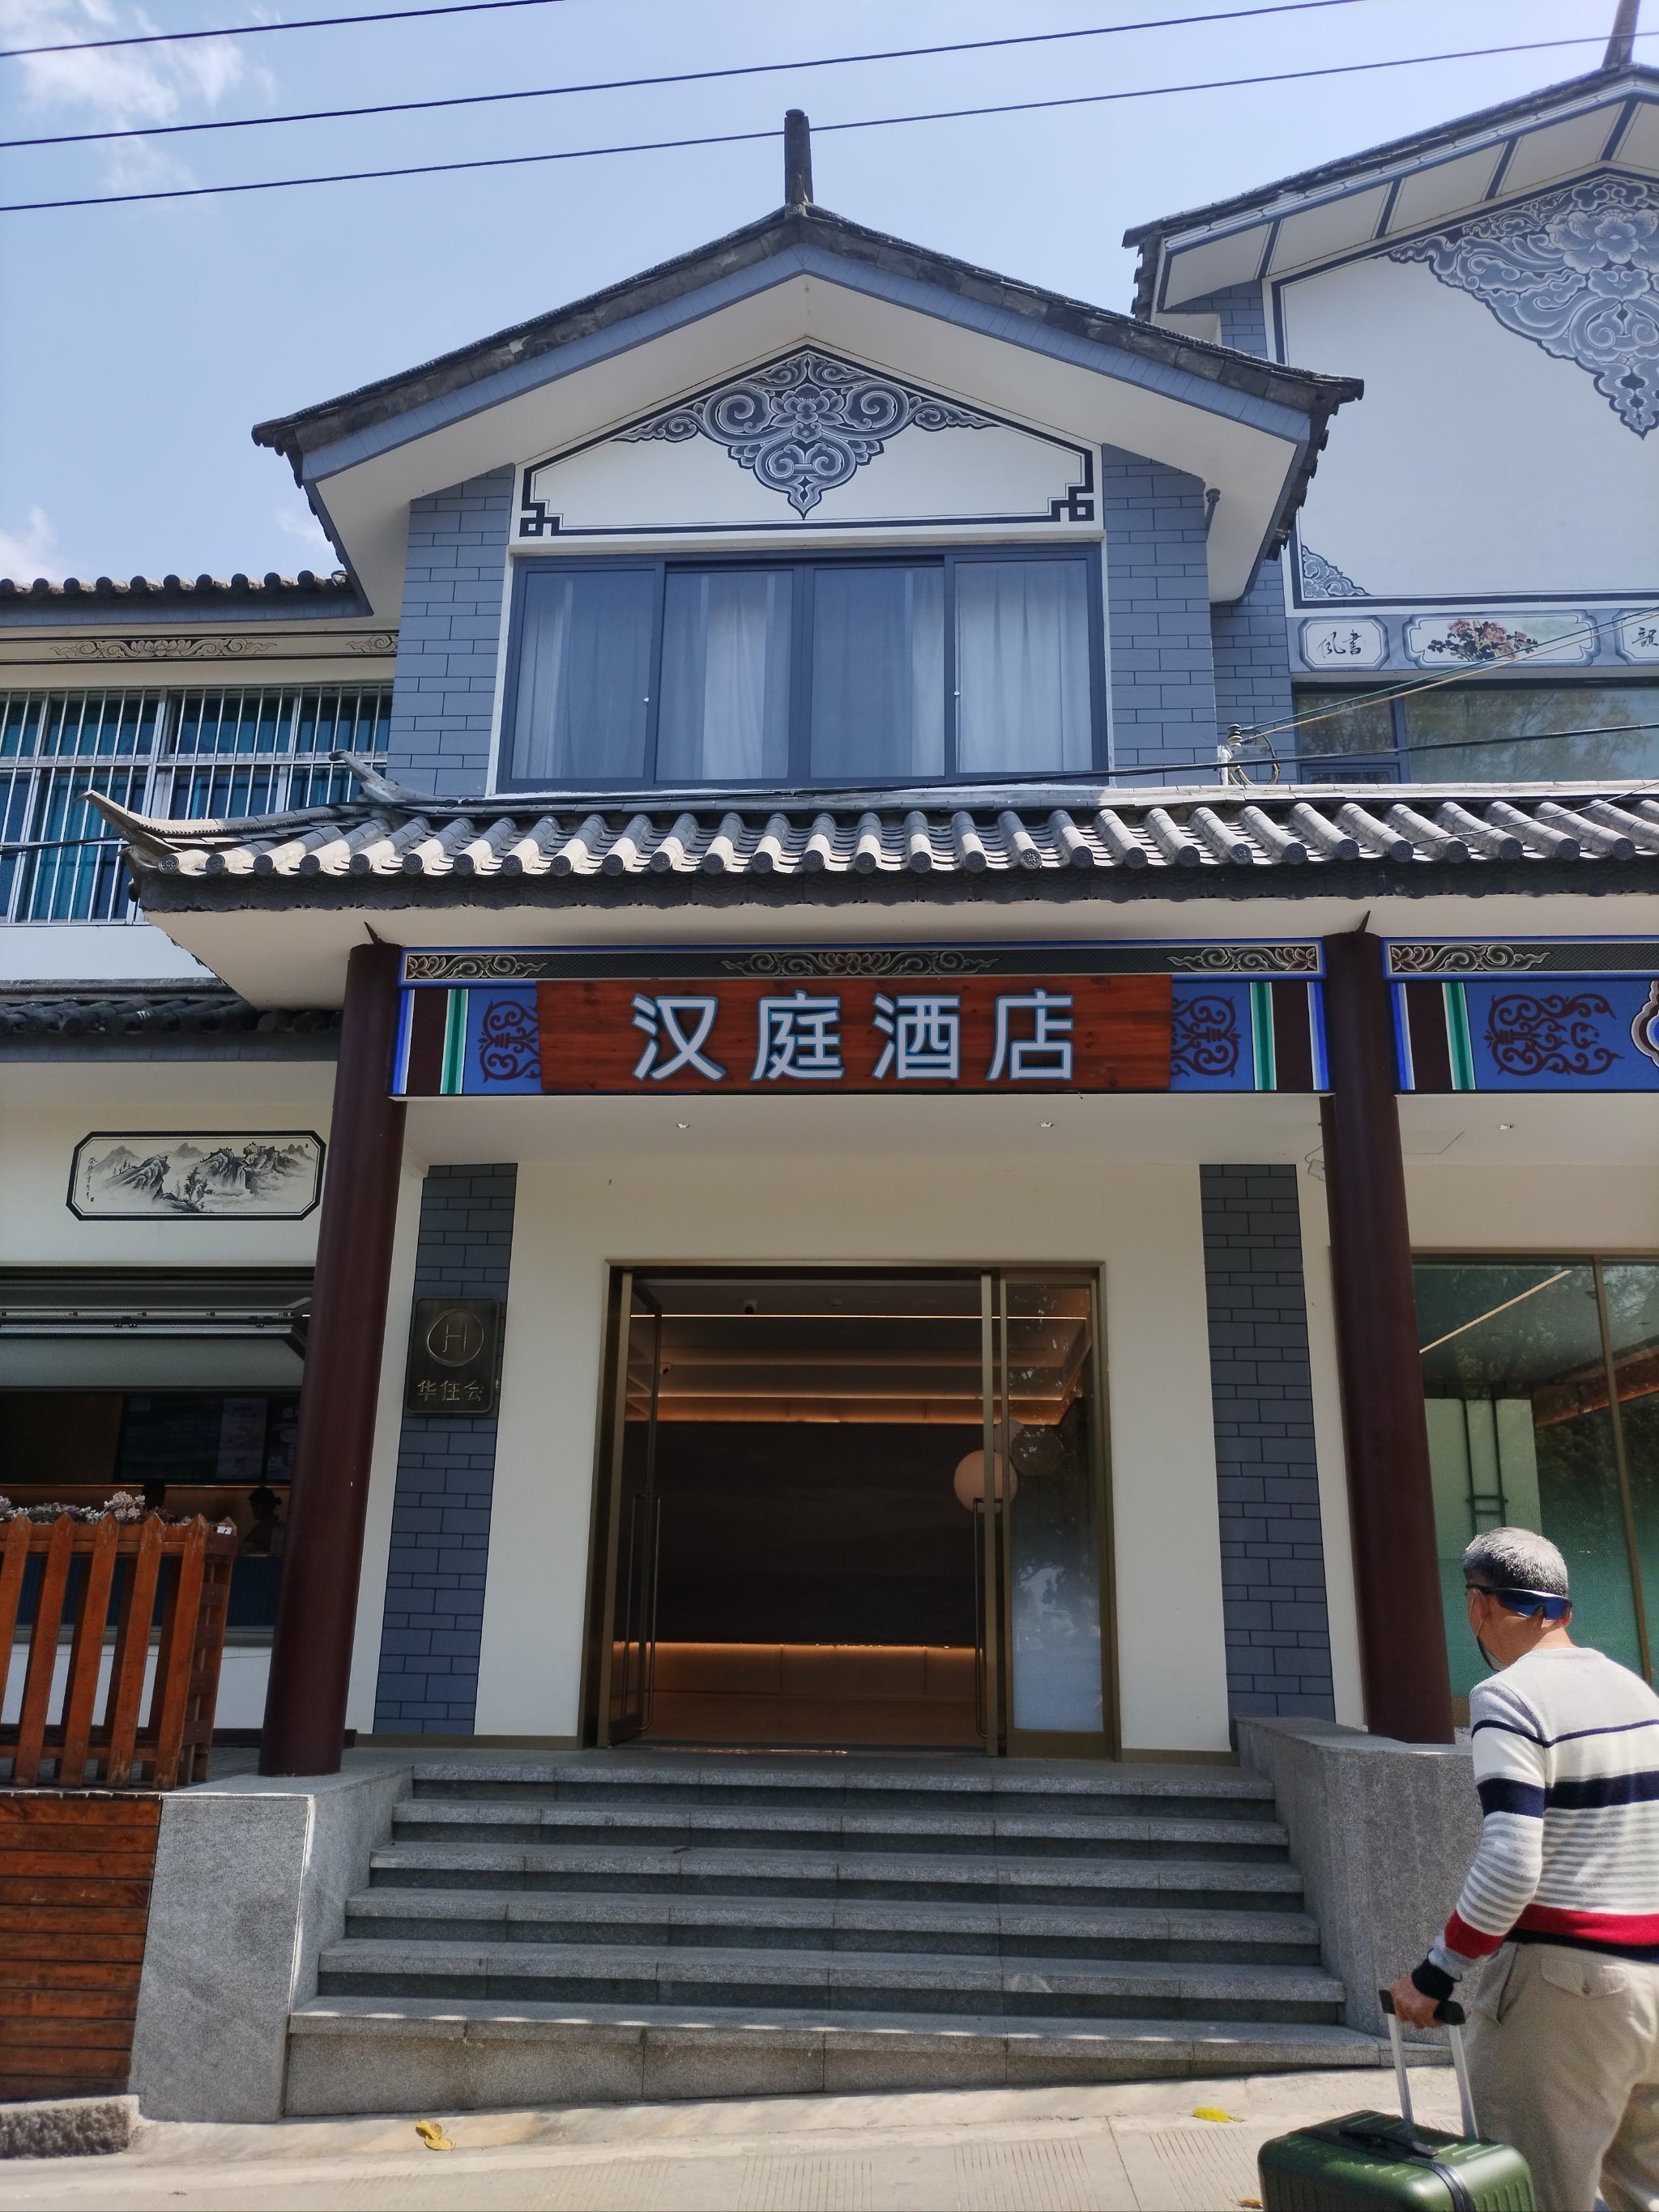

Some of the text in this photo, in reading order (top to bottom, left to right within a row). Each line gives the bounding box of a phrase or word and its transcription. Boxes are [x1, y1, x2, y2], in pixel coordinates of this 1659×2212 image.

[631, 989, 1073, 1080] 汉庭酒店
[417, 1379, 484, 1402] 华住会
